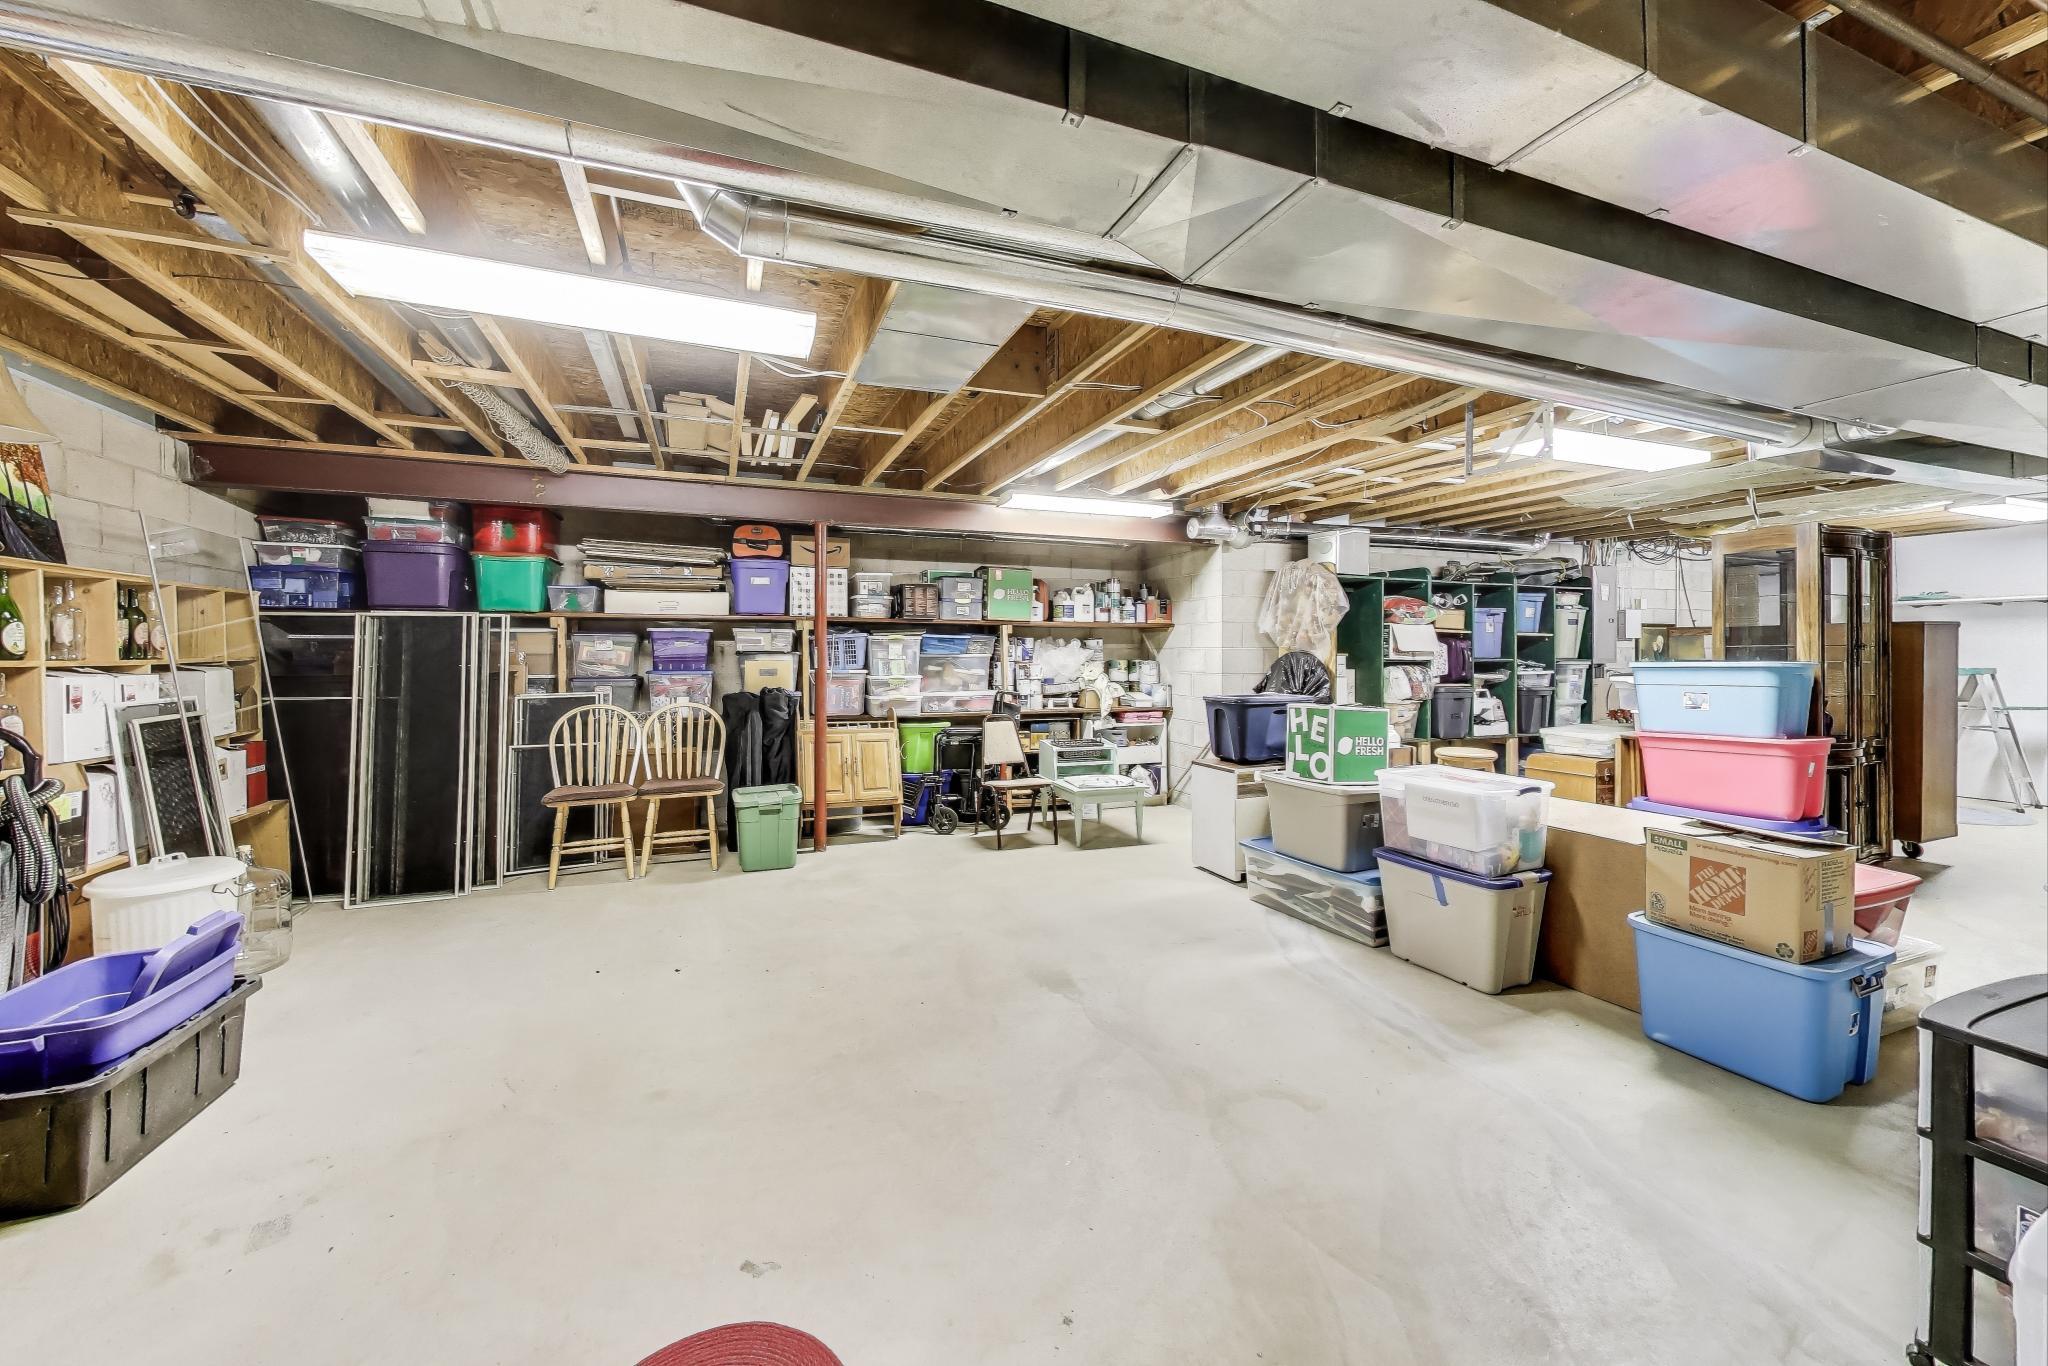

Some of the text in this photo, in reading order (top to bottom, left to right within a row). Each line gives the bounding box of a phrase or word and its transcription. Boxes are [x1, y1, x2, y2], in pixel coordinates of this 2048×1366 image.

[1355, 736, 1384, 746] HELLO
[1355, 746, 1384, 756] FRESH
[1653, 836, 1684, 849] SMALL
[1689, 865, 1746, 904] HOME
[1710, 885, 1745, 910] DEPOT
